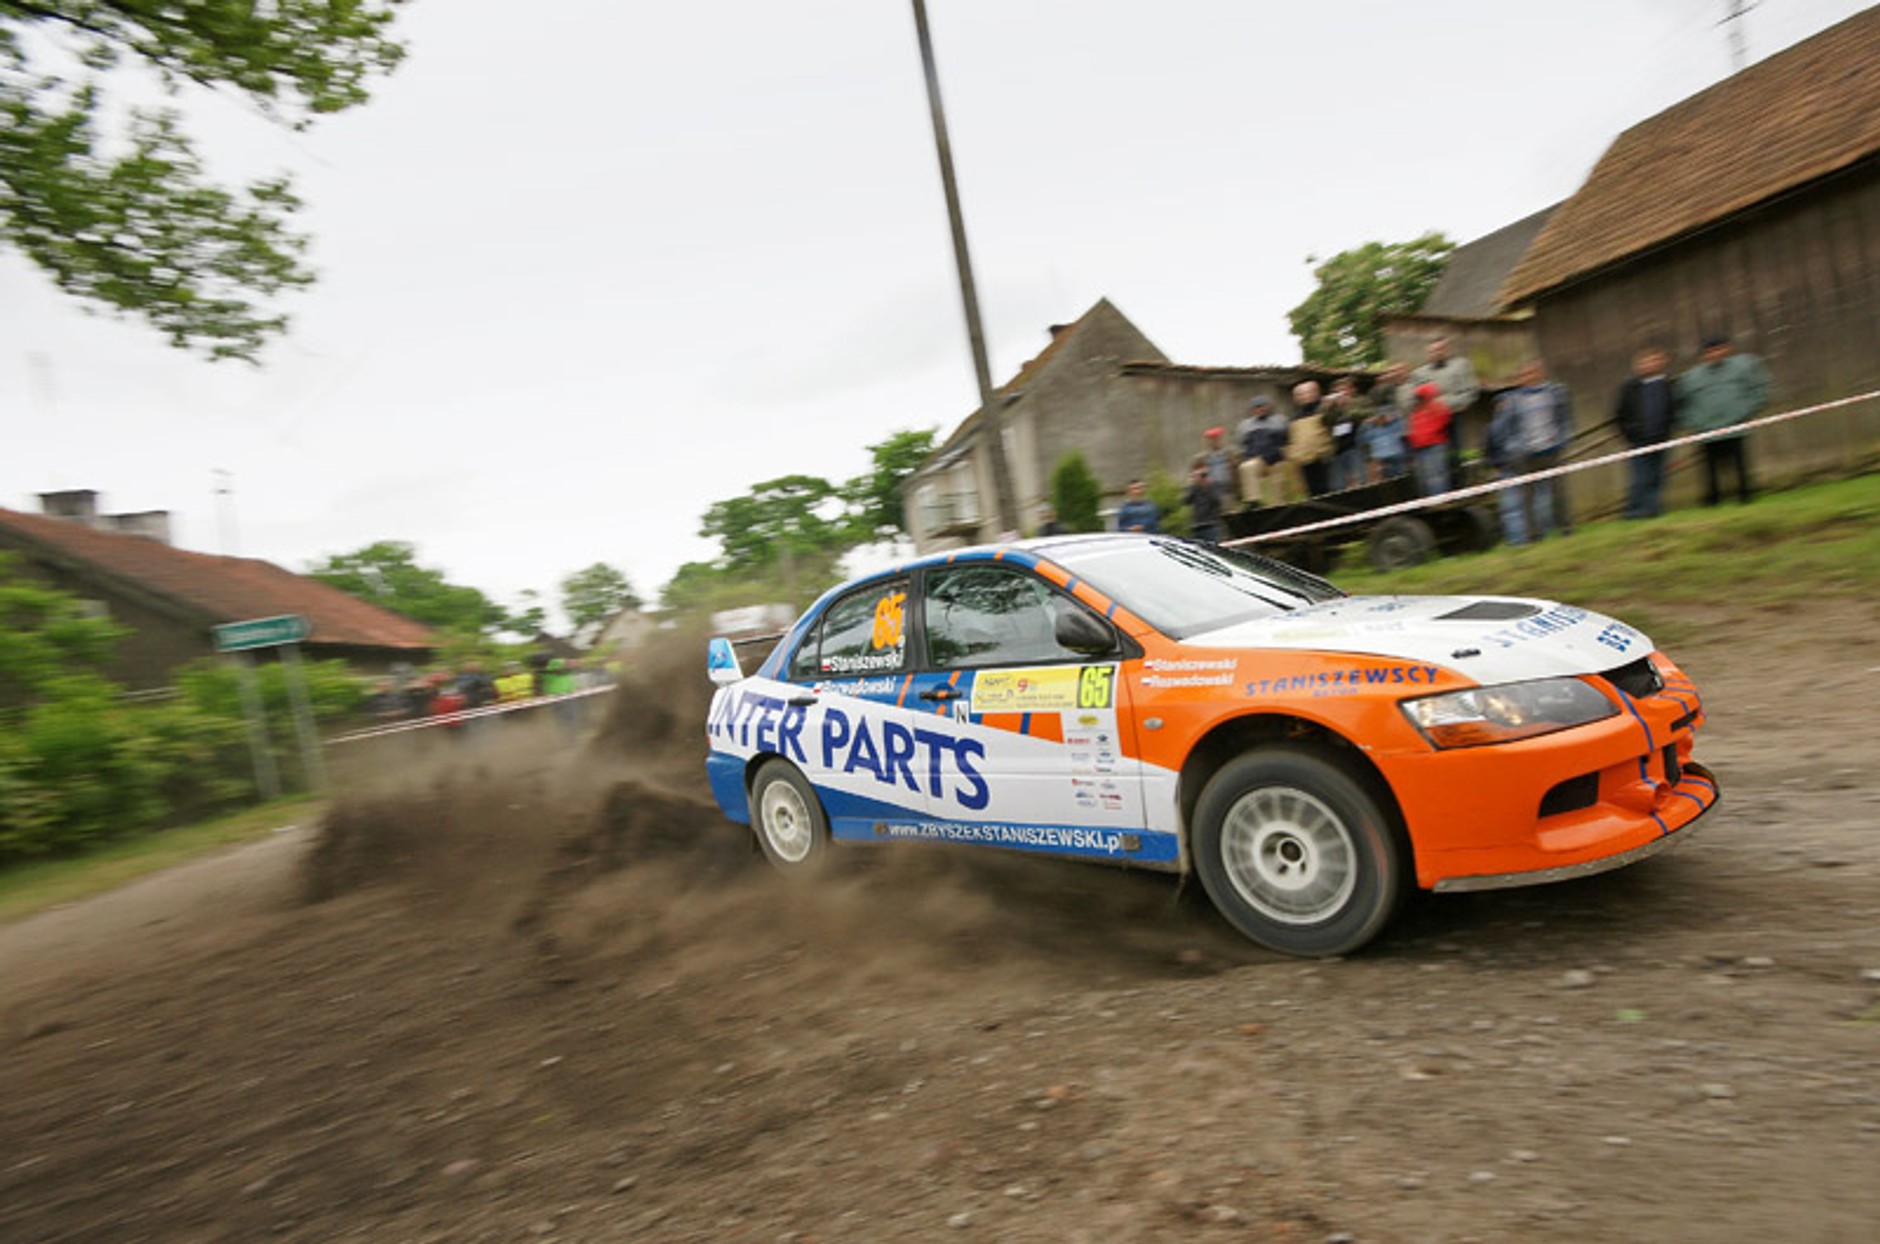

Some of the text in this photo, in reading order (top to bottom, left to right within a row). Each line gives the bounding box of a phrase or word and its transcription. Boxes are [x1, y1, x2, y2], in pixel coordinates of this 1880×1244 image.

[872, 592, 907, 651] 65
[1079, 666, 1114, 708] 65
[1245, 665, 1438, 697] STANISZEWSCY
[956, 704, 967, 724] N
[707, 688, 990, 811] INTER PARTS
